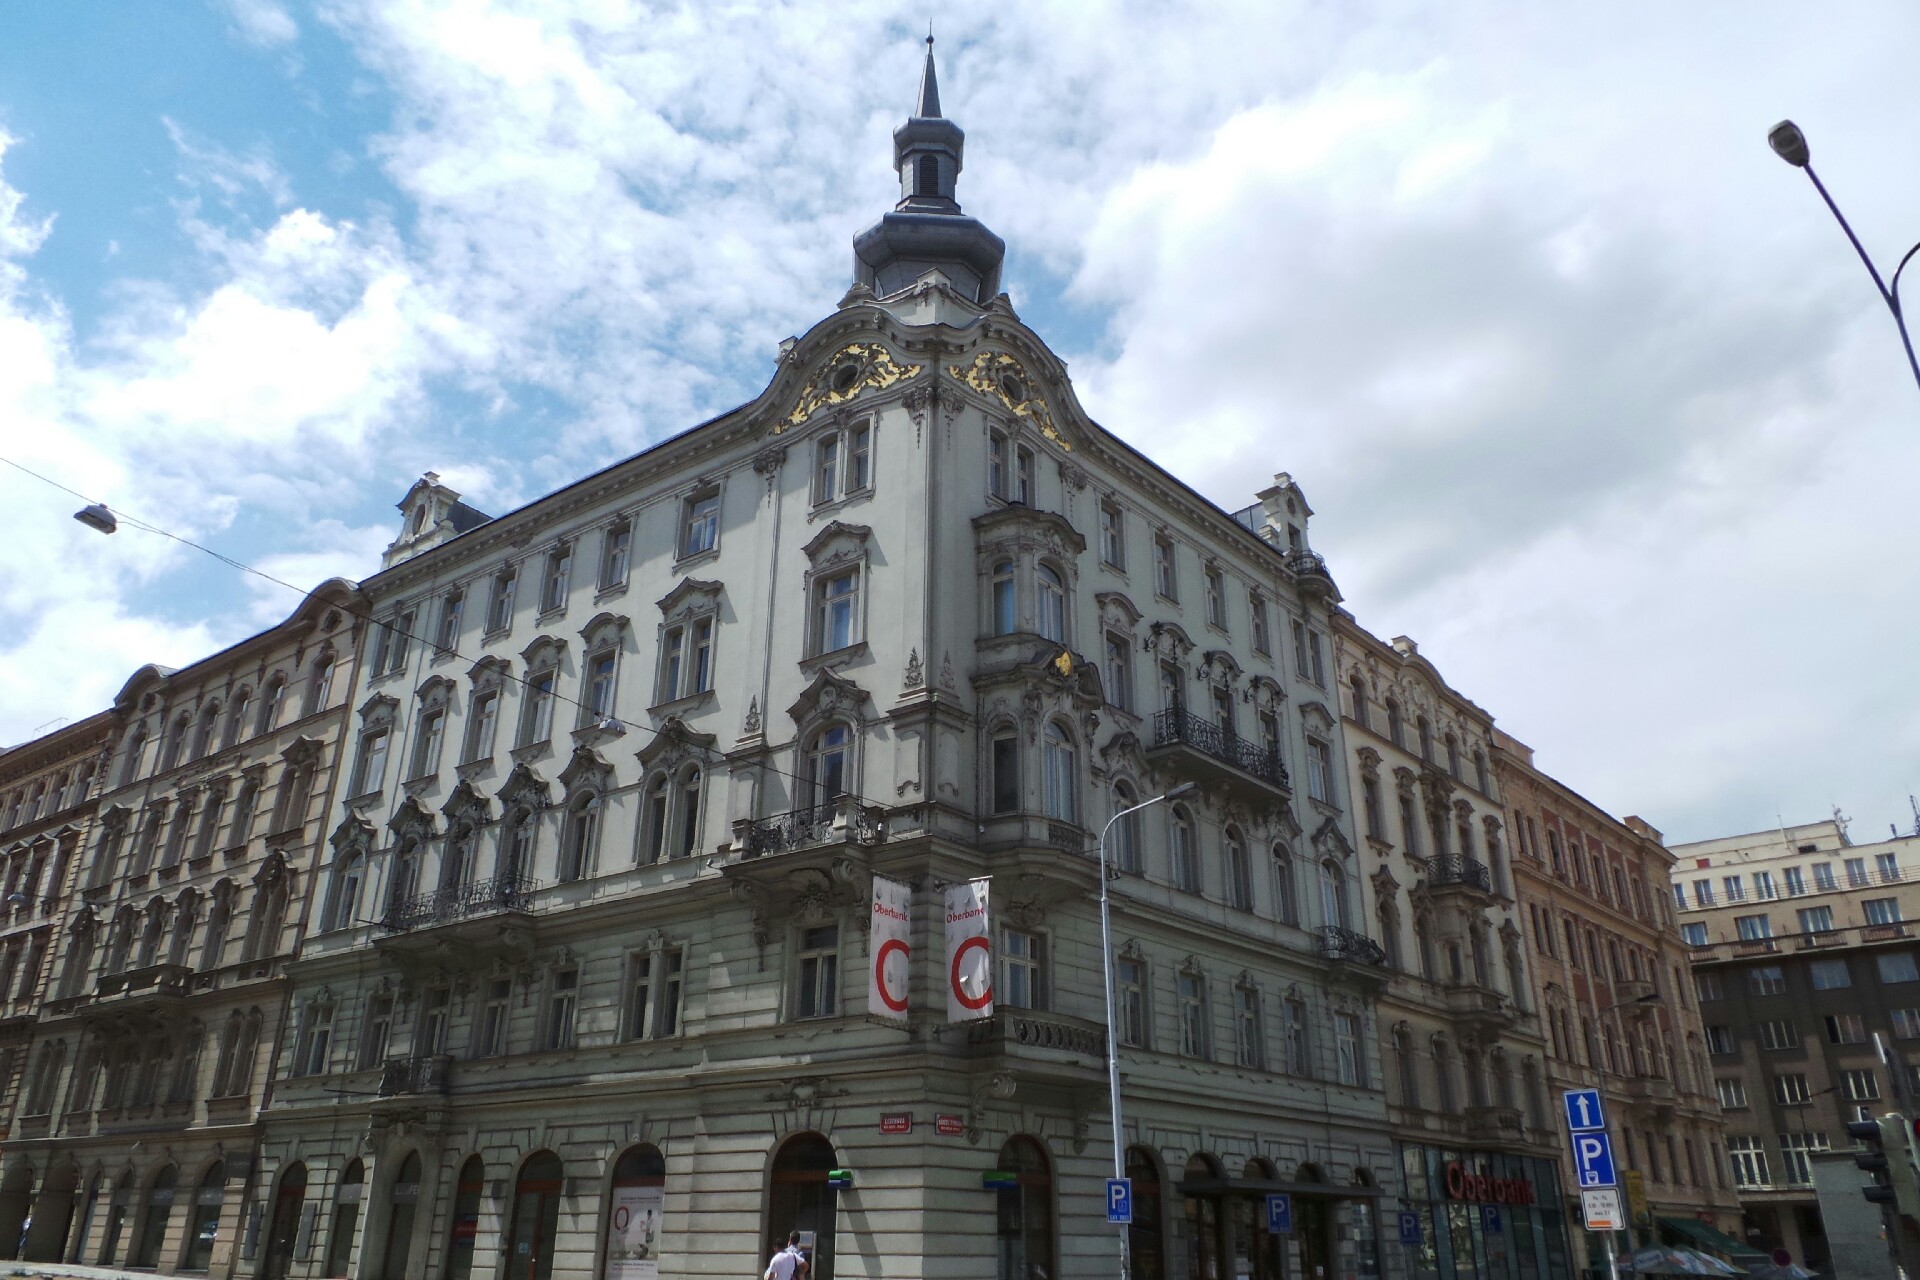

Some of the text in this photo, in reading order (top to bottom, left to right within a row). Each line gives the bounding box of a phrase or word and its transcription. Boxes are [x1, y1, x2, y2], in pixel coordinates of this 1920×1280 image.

[873, 902, 908, 922] Oberbank
[946, 907, 984, 924] Oberbank
[1580, 1138, 1602, 1170] P
[1111, 1184, 1126, 1209] P
[1271, 1199, 1285, 1221] P
[1485, 1207, 1496, 1224] P
[1402, 1215, 1415, 1235] P
